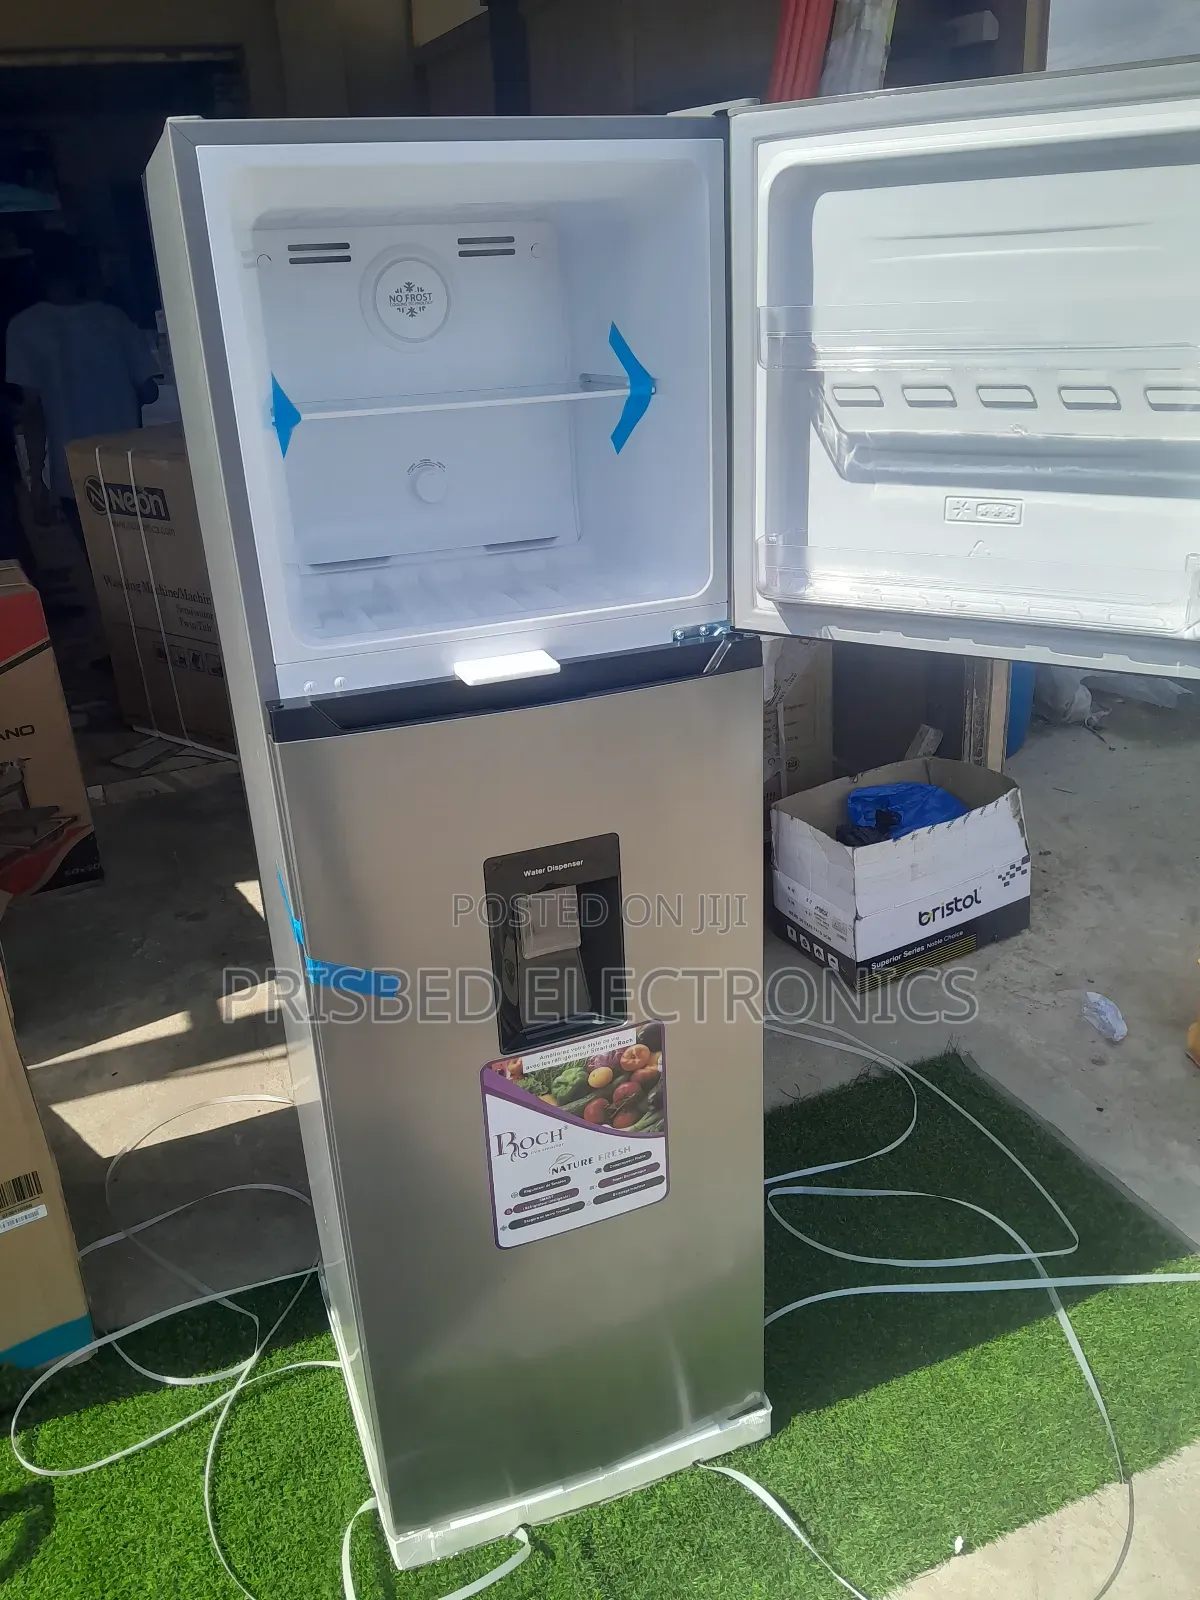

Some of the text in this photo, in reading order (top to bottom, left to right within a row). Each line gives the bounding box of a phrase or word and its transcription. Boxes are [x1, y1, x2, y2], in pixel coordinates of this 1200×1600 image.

[389, 292, 433, 303] NO FROST
[108, 486, 166, 517] Neon
[141, 580, 212, 606] Mchine/Machin
[523, 859, 584, 877] Water Dispenser
[918, 888, 982, 926] bristol
[871, 930, 964, 970] Superior Series Noble Choice
[617, 1038, 634, 1046] Roch
[551, 1145, 631, 1175] NATURE FRESH
